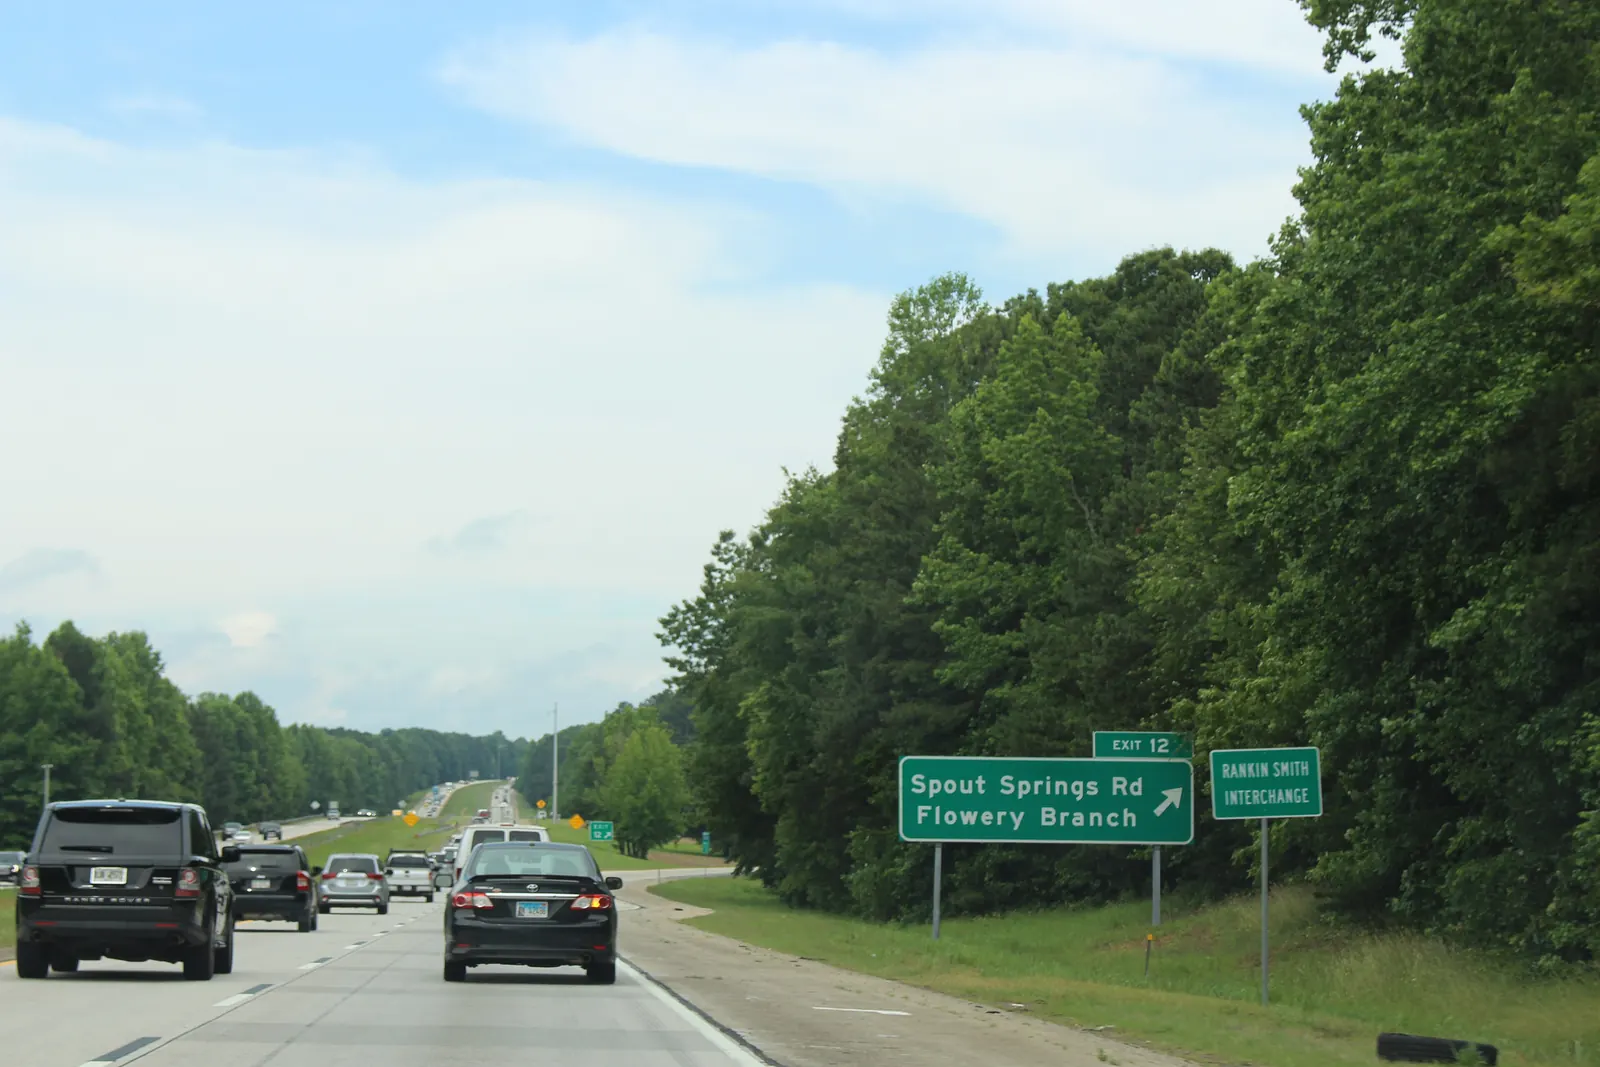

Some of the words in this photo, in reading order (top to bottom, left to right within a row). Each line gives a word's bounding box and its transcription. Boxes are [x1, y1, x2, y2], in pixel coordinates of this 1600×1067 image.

[1113, 740, 1141, 750] EXIT
[1150, 739, 1169, 753] 12
[1222, 762, 1269, 778] RANKIN
[1273, 761, 1309, 777] SMITH
[911, 774, 986, 799] Spout
[1000, 775, 1099, 801] Springs
[1112, 777, 1143, 796] Rd
[1224, 788, 1310, 806] INTERCHANGE
[917, 805, 1025, 830] Flowery
[1041, 807, 1137, 827] Branch
